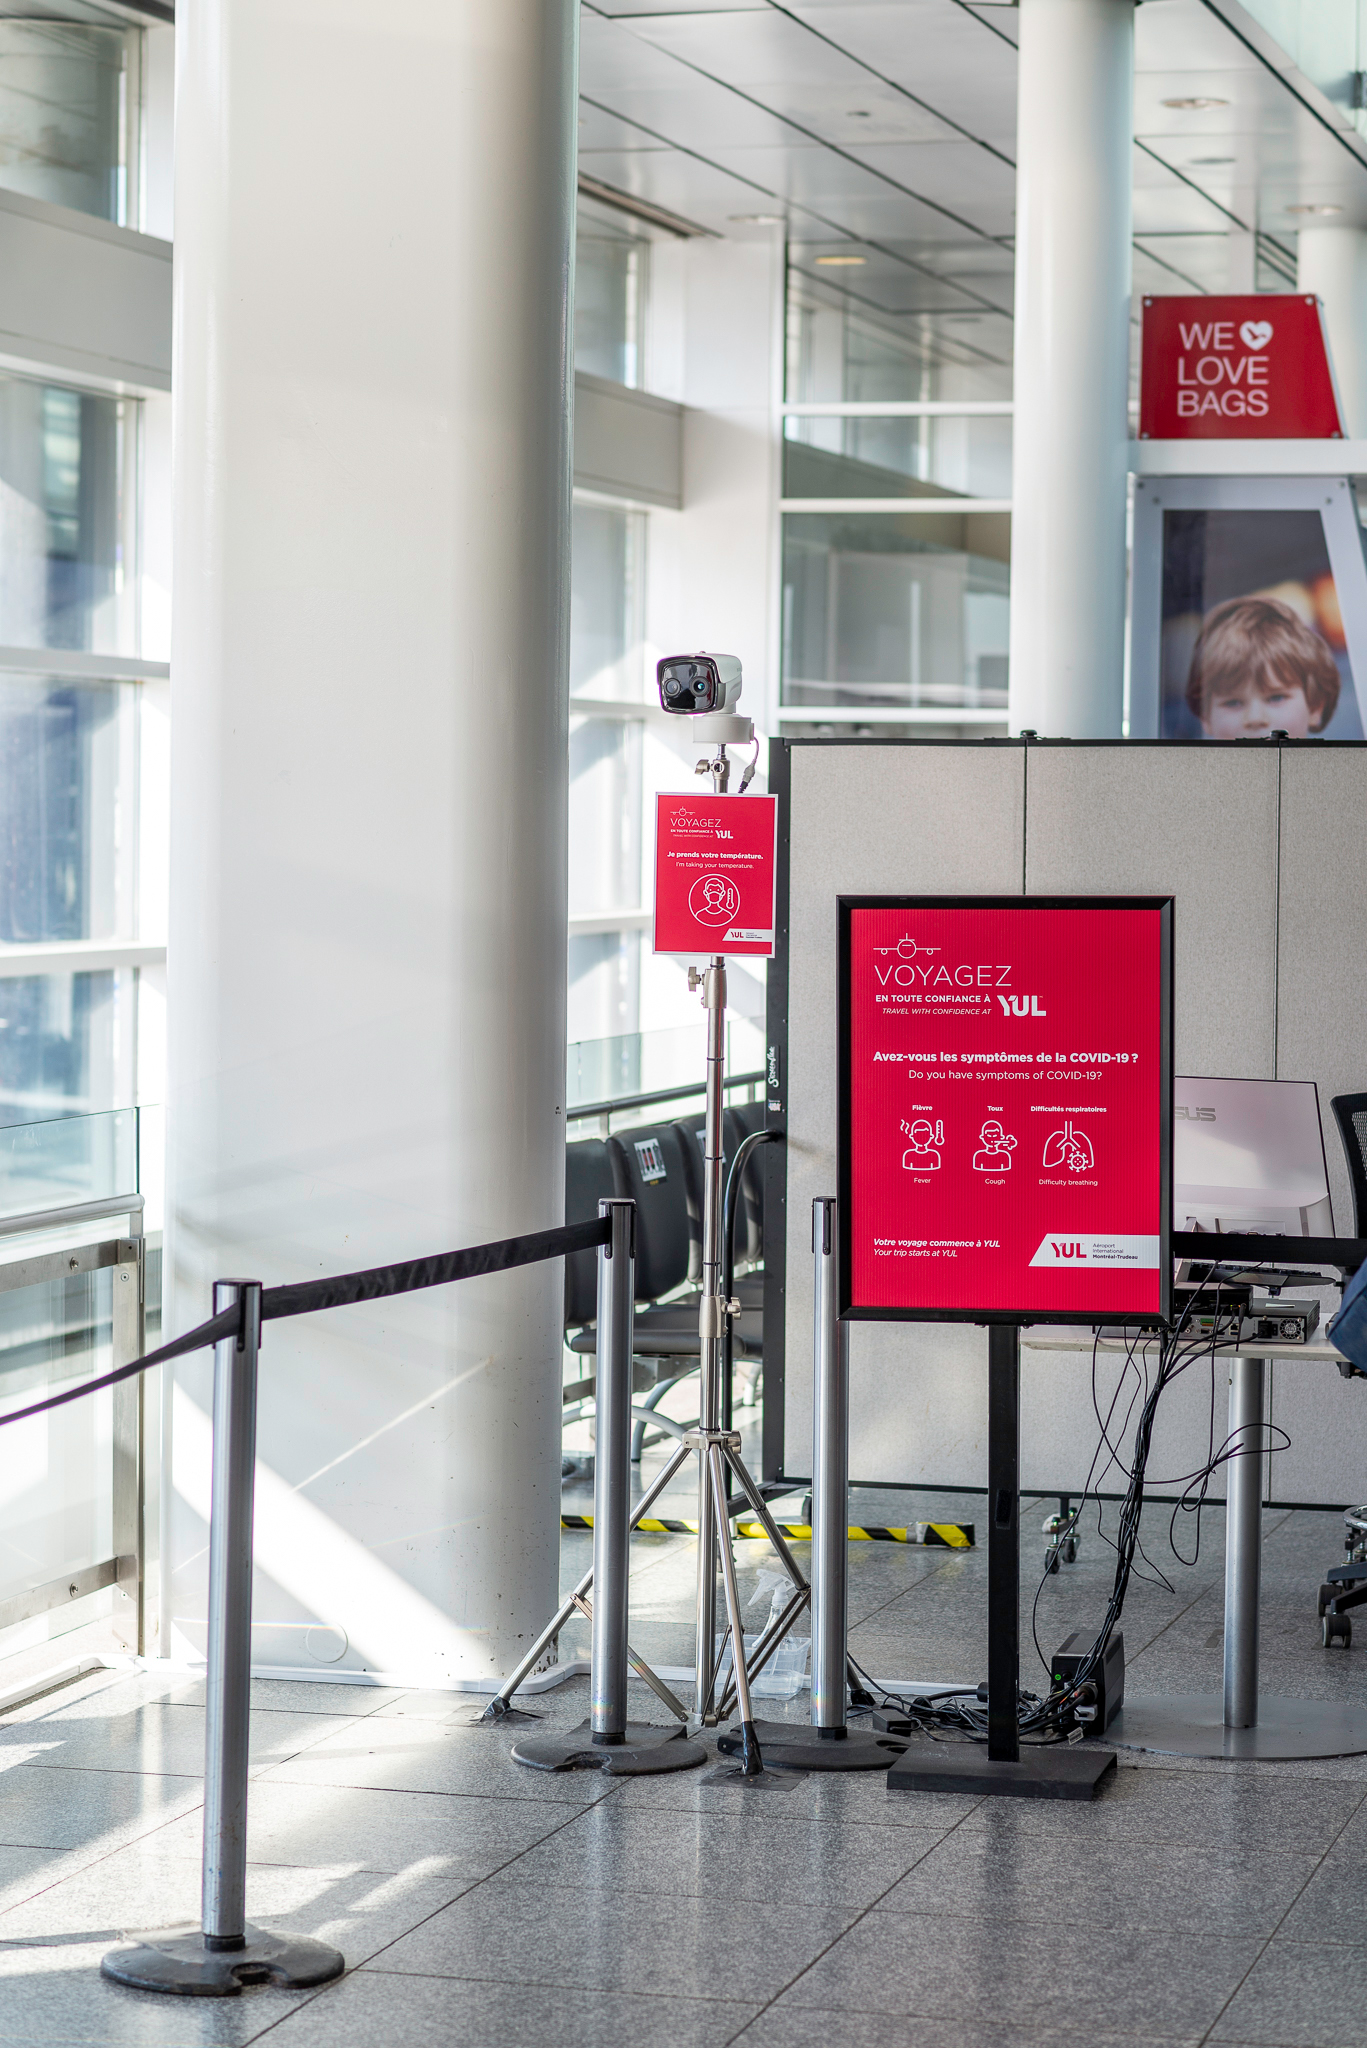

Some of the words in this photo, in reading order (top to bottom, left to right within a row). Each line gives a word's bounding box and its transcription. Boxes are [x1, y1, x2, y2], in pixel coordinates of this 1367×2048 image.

[1178, 322, 1235, 350] WE
[1177, 356, 1269, 385] LOVE
[1177, 389, 1269, 417] BAGS
[670, 818, 721, 828] VOYAGEZ
[715, 830, 734, 839] YUL
[676, 851, 700, 859] prends
[720, 852, 764, 860] température.
[874, 964, 1013, 987] VOYAGEZ
[875, 994, 889, 1003] EN
[890, 994, 923, 1003] TOUTE
[924, 994, 982, 1003] CONFIANCE
[983, 993, 991, 1003] À
[882, 1007, 910, 1015] TRAVEL
[996, 995, 1047, 1017] YUL
[873, 1051, 937, 1062] Avez-vous
[940, 1051, 958, 1062] les
[960, 1052, 1033, 1064] symptômes
[1036, 1052, 1052, 1063] de
[1055, 1052, 1067, 1063] la
[908, 1069, 924, 1079] Do
[926, 1071, 946, 1081] you
[948, 1070, 973, 1079] have
[975, 1071, 1030, 1081] symptoms
[1032, 1070, 1044, 1080] of
[1046, 1071, 1103, 1080] COVID-19?
[1175, 1106, 1217, 1122] SUS
[984, 1178, 1006, 1186] Cough
[1038, 1178, 1067, 1186] Difficulty
[1068, 1179, 1098, 1187] breathing
[873, 1238, 896, 1246] Votre
[898, 1239, 927, 1248] voyage
[929, 1240, 975, 1248] commence
[976, 1239, 981, 1248] à
[984, 1240, 1001, 1248] YUL
[873, 1248, 892, 1256] Your
[893, 1249, 907, 1257] trip
[908, 1249, 931, 1257] starts
[942, 1249, 958, 1258] YUL
[1050, 1242, 1087, 1259] YUL
